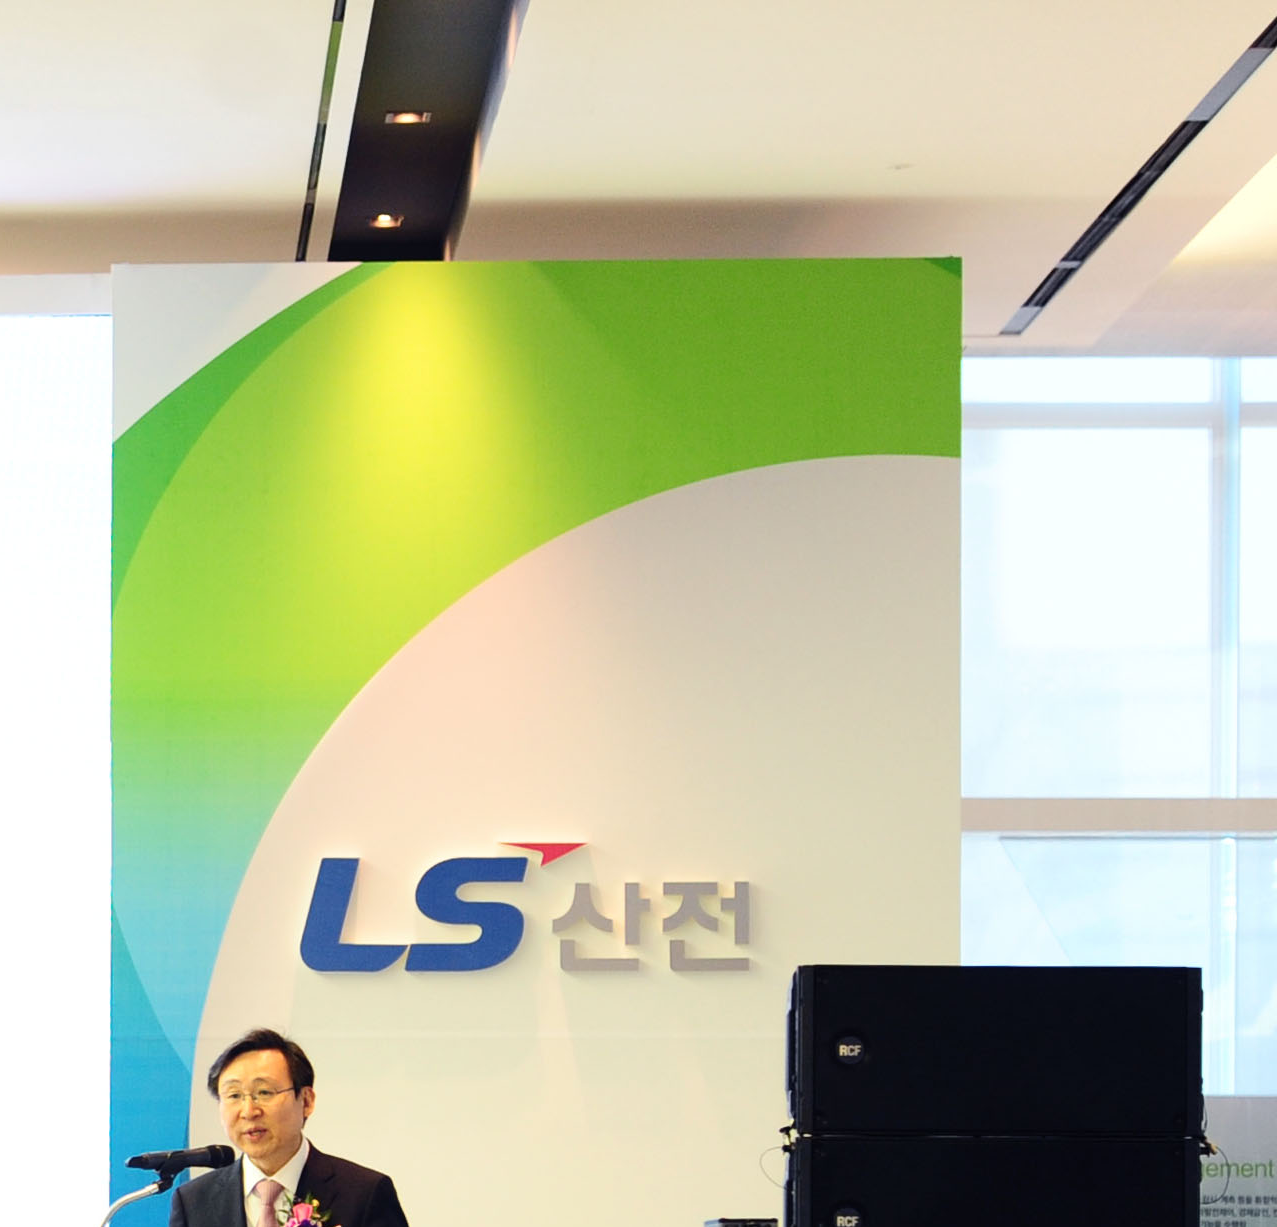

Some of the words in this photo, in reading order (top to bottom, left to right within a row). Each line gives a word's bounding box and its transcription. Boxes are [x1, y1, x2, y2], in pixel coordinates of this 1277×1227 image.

[839, 1044, 861, 1056] RCF
[1202, 1160, 1274, 1178] ement
[836, 1216, 859, 1227] RCF
